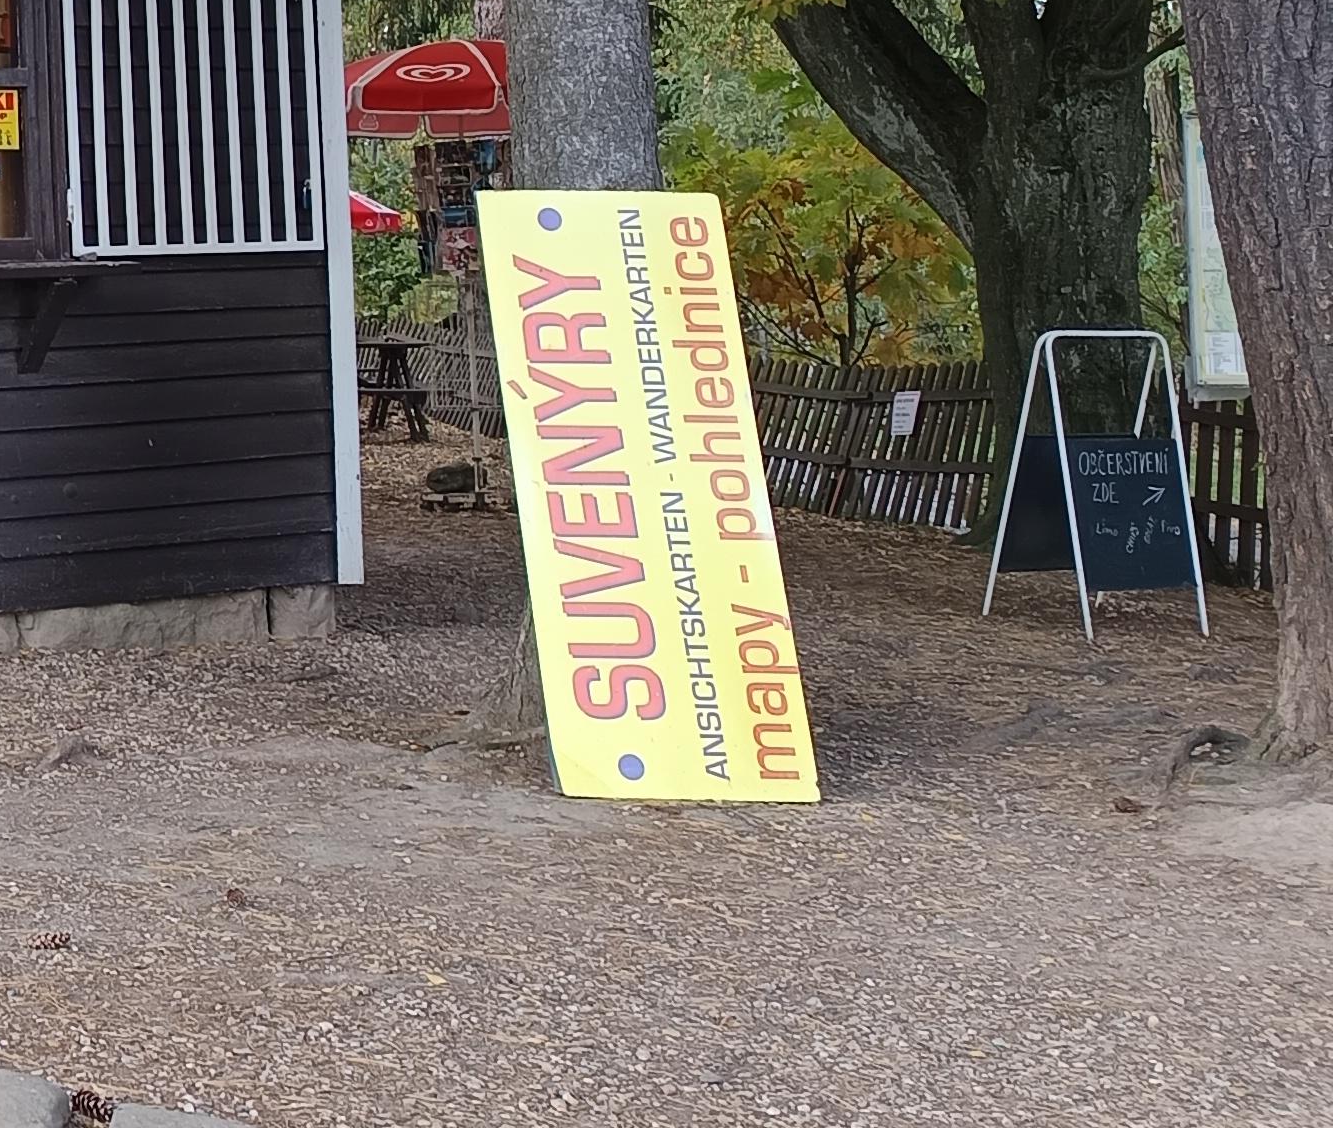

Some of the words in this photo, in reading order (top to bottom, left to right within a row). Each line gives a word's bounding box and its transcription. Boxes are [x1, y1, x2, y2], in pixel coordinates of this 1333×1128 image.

[617, 209, 677, 464] WANDERKARTEN
[663, 216, 776, 541] pohlednice
[506, 254, 666, 720] SUVENÝRY
[1091, 481, 1120, 504] ZDE
[659, 491, 731, 781] ANSICHTSKARTEN
[730, 603, 800, 780] mapy
